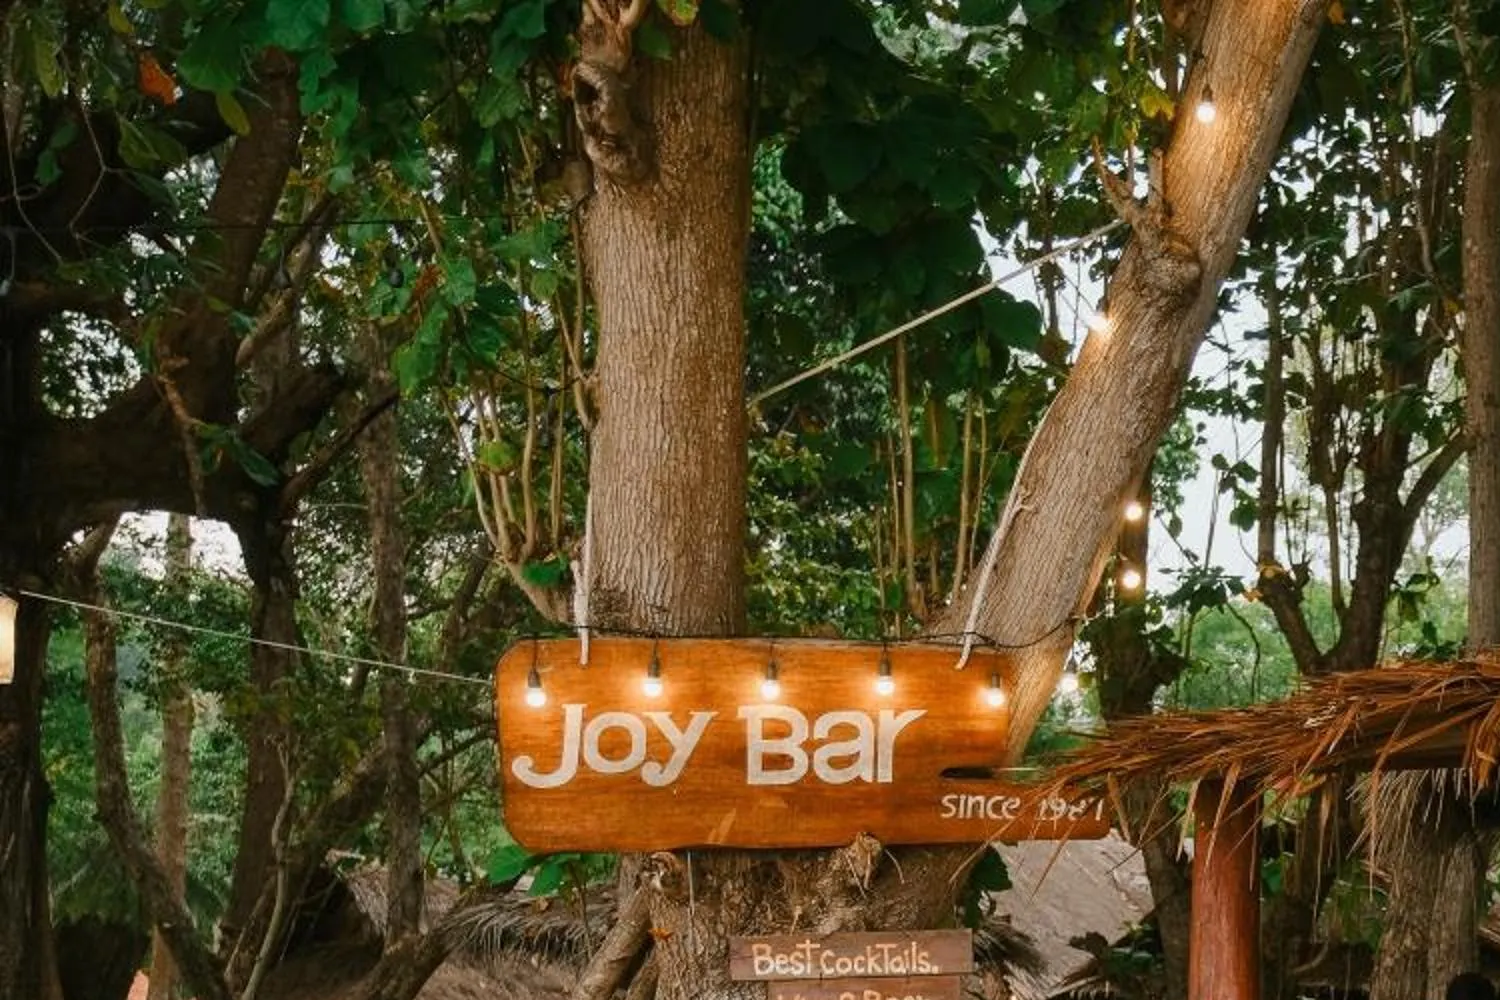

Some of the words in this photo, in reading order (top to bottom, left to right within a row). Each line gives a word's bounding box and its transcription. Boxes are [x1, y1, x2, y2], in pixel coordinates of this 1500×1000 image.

[511, 703, 720, 788] Joy
[737, 705, 927, 786] Bar
[941, 793, 1021, 819] since
